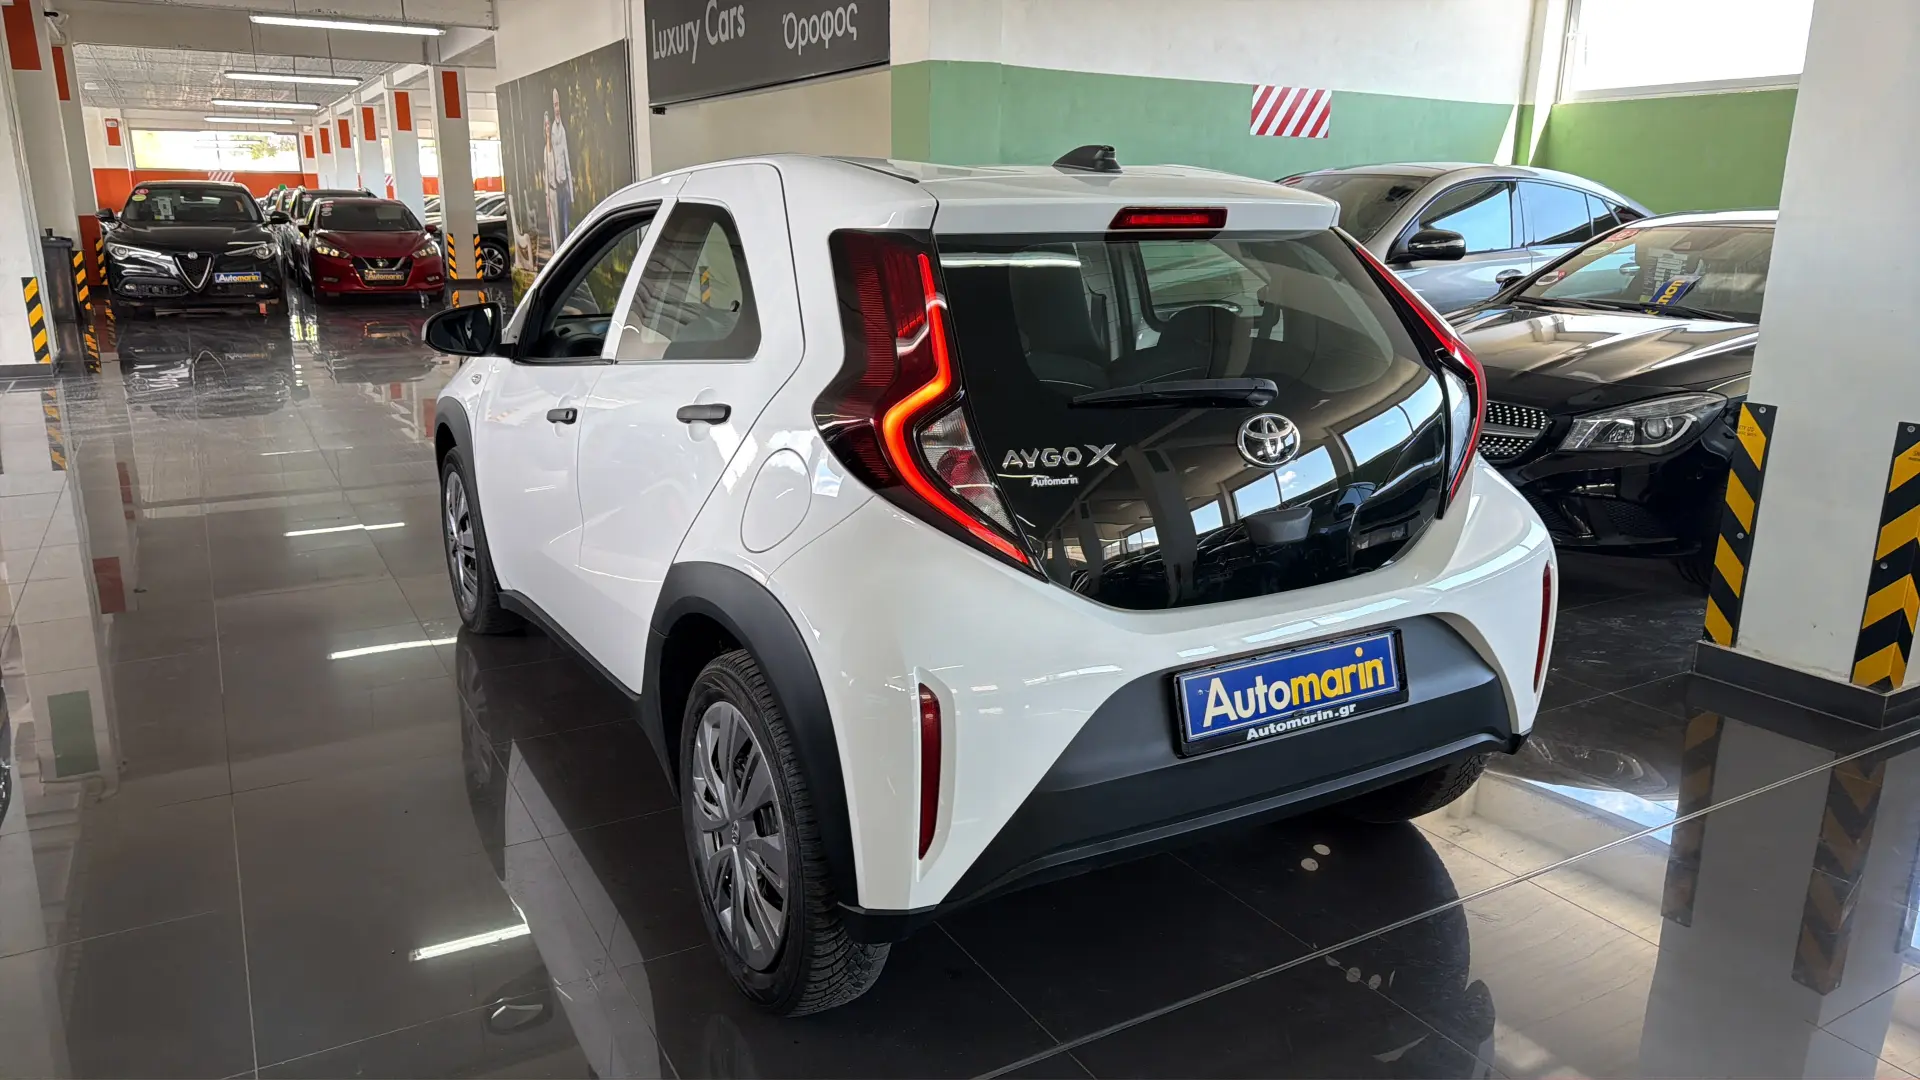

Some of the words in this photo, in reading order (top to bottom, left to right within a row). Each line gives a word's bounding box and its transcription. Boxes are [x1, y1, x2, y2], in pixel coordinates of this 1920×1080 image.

[652, 19, 700, 64] Luxury
[705, 0, 746, 45] Cars
[782, 2, 858, 56] Όροφος
[218, 273, 259, 282] Automarin
[1002, 447, 1082, 469] AYGO
[1084, 443, 1118, 468] X
[1030, 474, 1079, 487] Automarin
[1203, 646, 1385, 728] Automarin
[1246, 703, 1357, 741] Automarin.gr
